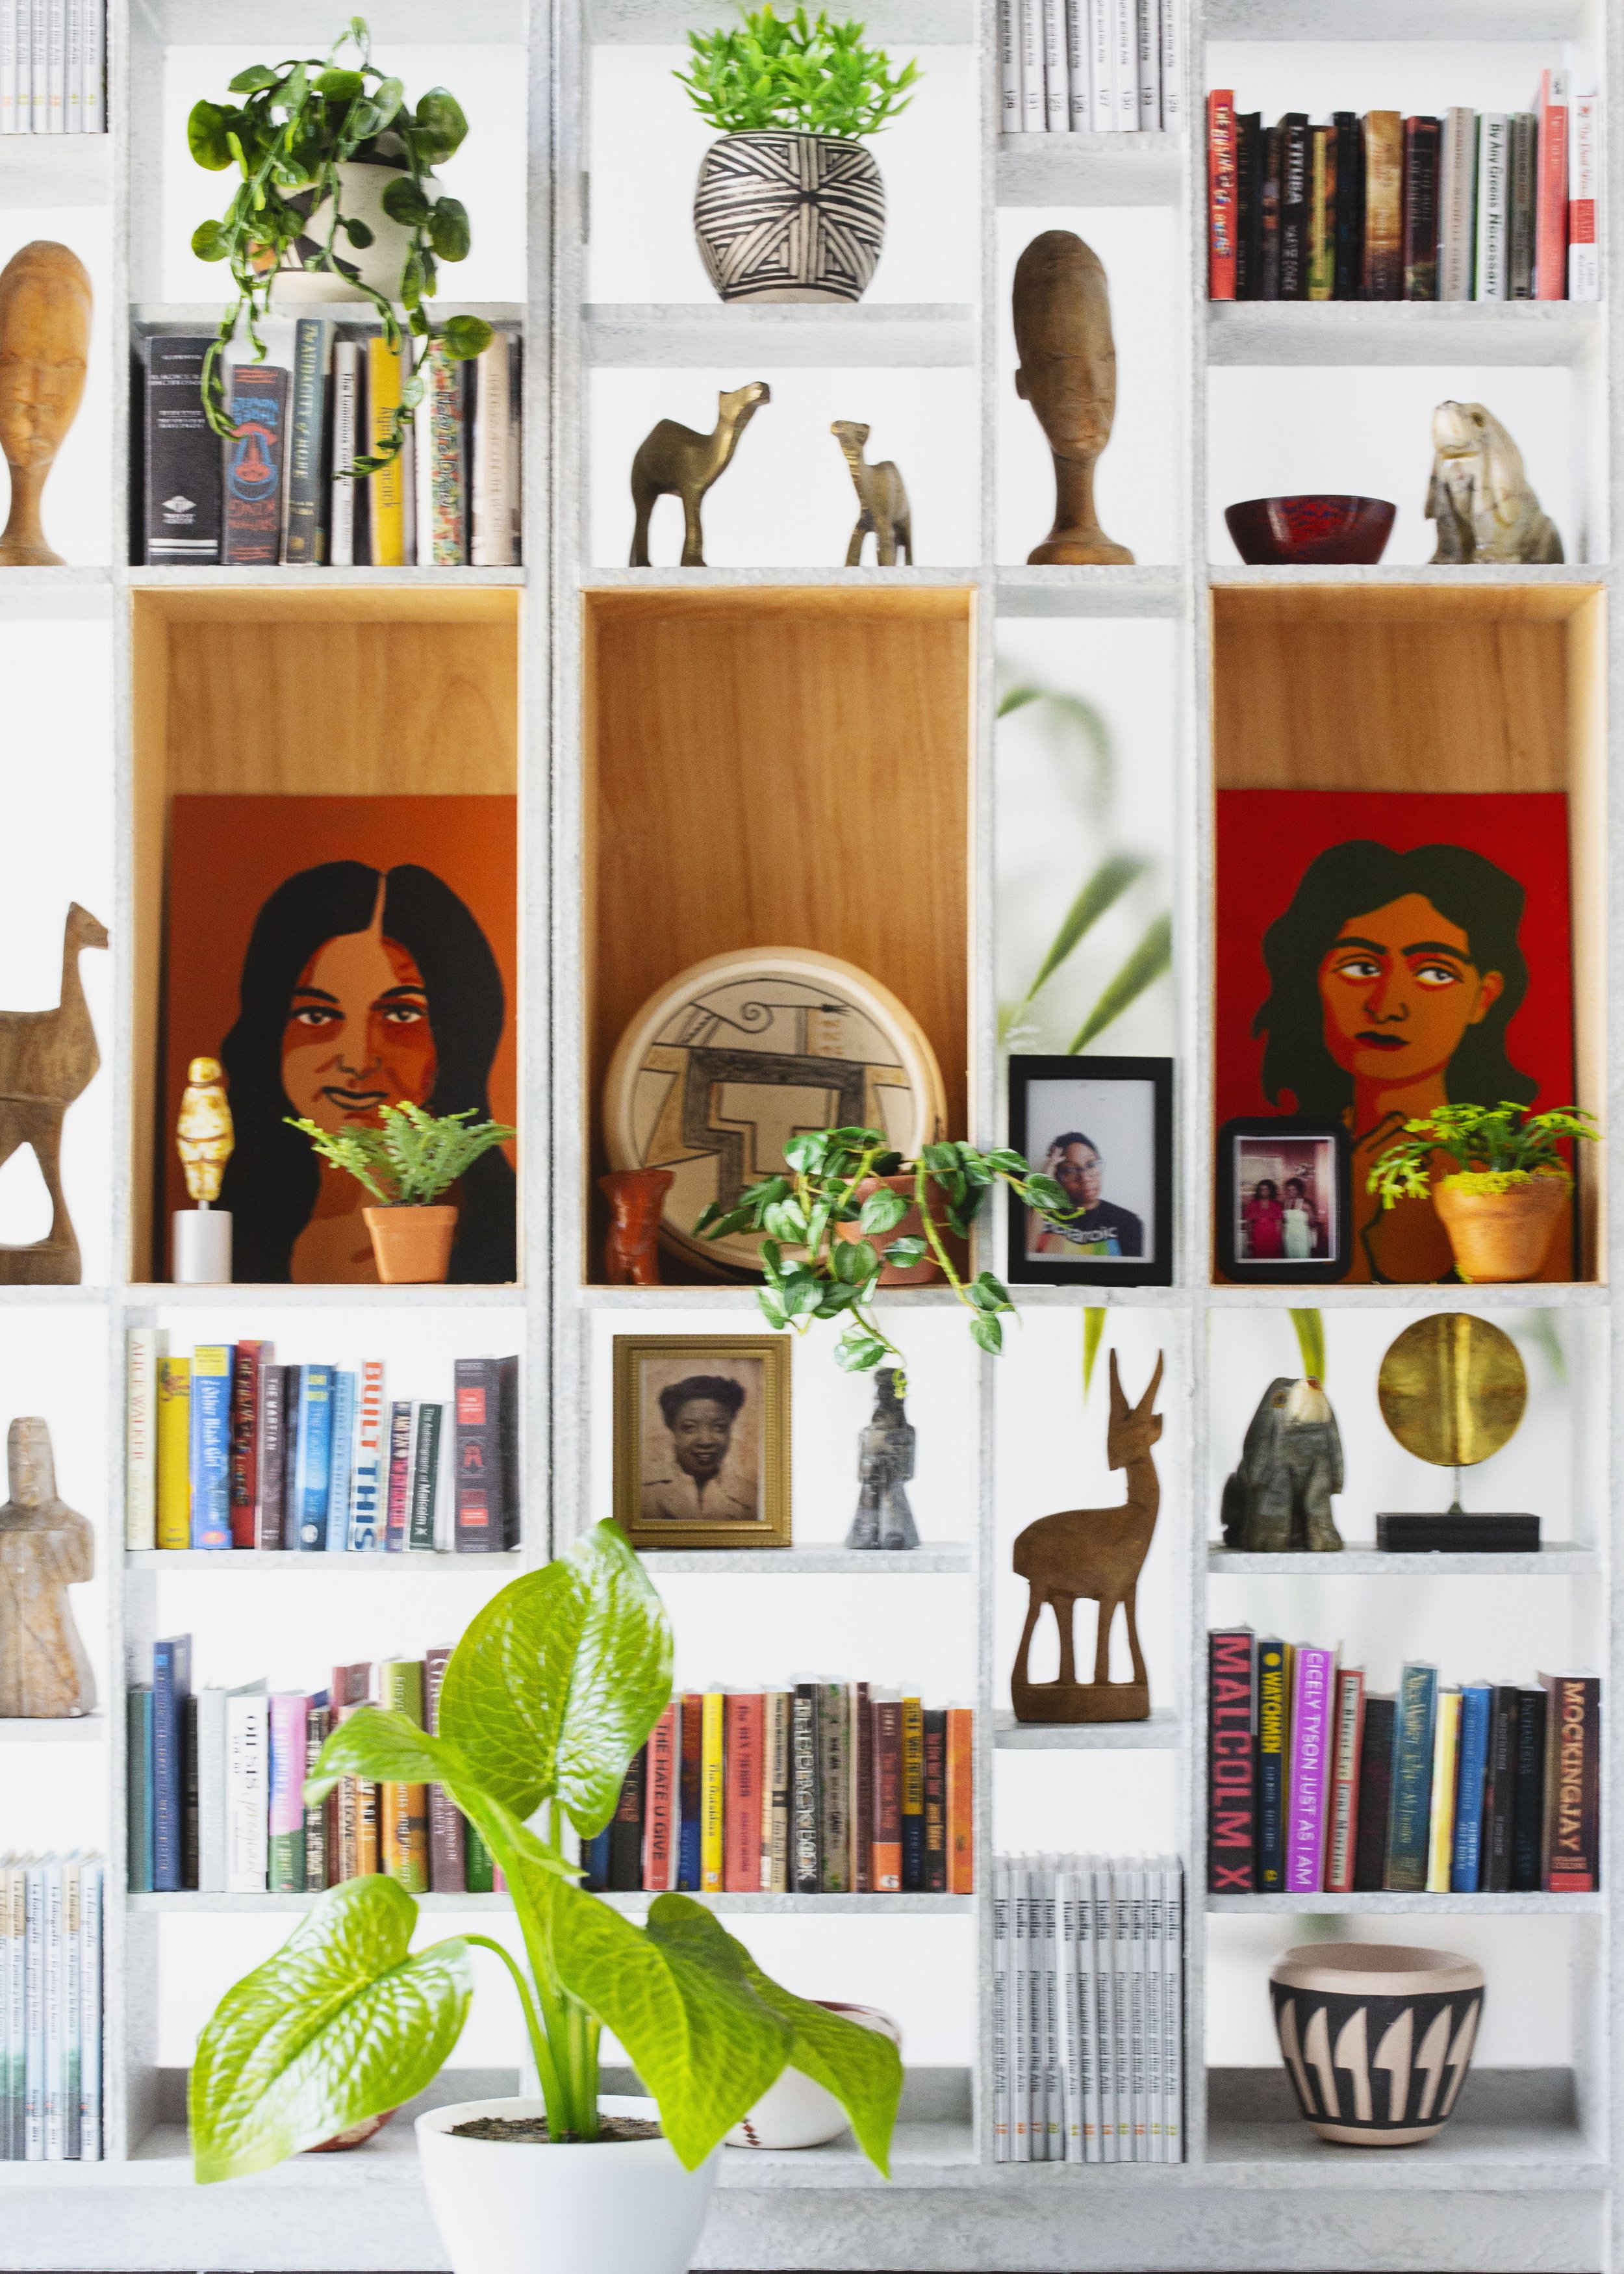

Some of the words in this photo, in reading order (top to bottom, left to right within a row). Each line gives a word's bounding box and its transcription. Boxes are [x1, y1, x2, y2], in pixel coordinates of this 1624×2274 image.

[1490, 123, 1503, 138] By
[1488, 141, 1503, 163] Any
[1288, 142, 1304, 206] TITUBA
[1488, 166, 1502, 208] Greens
[1453, 187, 1464, 240] MICHELLE
[1579, 203, 1595, 241] PRADA
[1451, 248, 1462, 290] OBAMA
[1486, 213, 1502, 296] Necessary
[298, 344, 317, 417] AUDACITY
[341, 373, 353, 391] The
[340, 394, 354, 444] Luminous
[437, 390, 455, 429] How
[293, 439, 309, 479] HOPE
[436, 460, 457, 508] Draw
[130, 1341, 146, 1389] ALICE
[200, 1386, 221, 1416] Other
[266, 1379, 278, 1397] THE
[361, 1361, 385, 1453] BUILT
[129, 1394, 146, 1461] WALKER
[203, 1418, 222, 1445] Black
[265, 1401, 279, 1450] MARTIAN
[423, 1409, 435, 1422] The
[203, 1448, 222, 1467] Girl
[418, 1422, 434, 1473] Autobiography
[420, 1474, 430, 1483] of
[354, 1459, 380, 1550] THIS
[415, 1483, 431, 1525] Malcolm
[1304, 1653, 1325, 1710] CICELY
[1343, 1680, 1358, 1701] The
[1404, 1672, 1429, 1700] Alice
[1260, 1670, 1282, 1754] WATCHMEN
[1340, 1708, 1357, 1748] Bluest
[1403, 1703, 1427, 1744] Walker
[654, 1724, 670, 1753] THE
[1213, 1635, 1252, 1847] MALCOLM
[1299, 1713, 1323, 1770] TYSON
[654, 1759, 668, 1800] HATE
[709, 1764, 719, 1782] The
[1338, 1756, 1354, 1777] Eye
[1558, 1681, 1586, 1852] MOCKINGJAY
[794, 1755, 816, 1823] BLACK
[1298, 1776, 1319, 1815] JUST
[1337, 1786, 1351, 1813] Toni
[396, 1811, 410, 1834] and
[653, 1806, 667, 1817] U
[707, 1785, 719, 1837] Outsiders
[1296, 1819, 1316, 1841] AS
[397, 1837, 412, 1884] Flowers
[653, 1822, 667, 1860] GIVE
[796, 1829, 817, 1881] BOOK
[1332, 1819, 1349, 1879] Morrison
[773, 1858, 784, 1884] Hurston
[1213, 1865, 1252, 1888] X
[1294, 1855, 1313, 1885] AM
[995, 2037, 1008, 2054] and
[1029, 2036, 1043, 2054] and
[1066, 2039, 1078, 2056] and
[995, 2075, 1008, 2093] Arts
[1030, 2074, 1043, 2093] Arts
[1067, 2076, 1079, 2095] Arts
